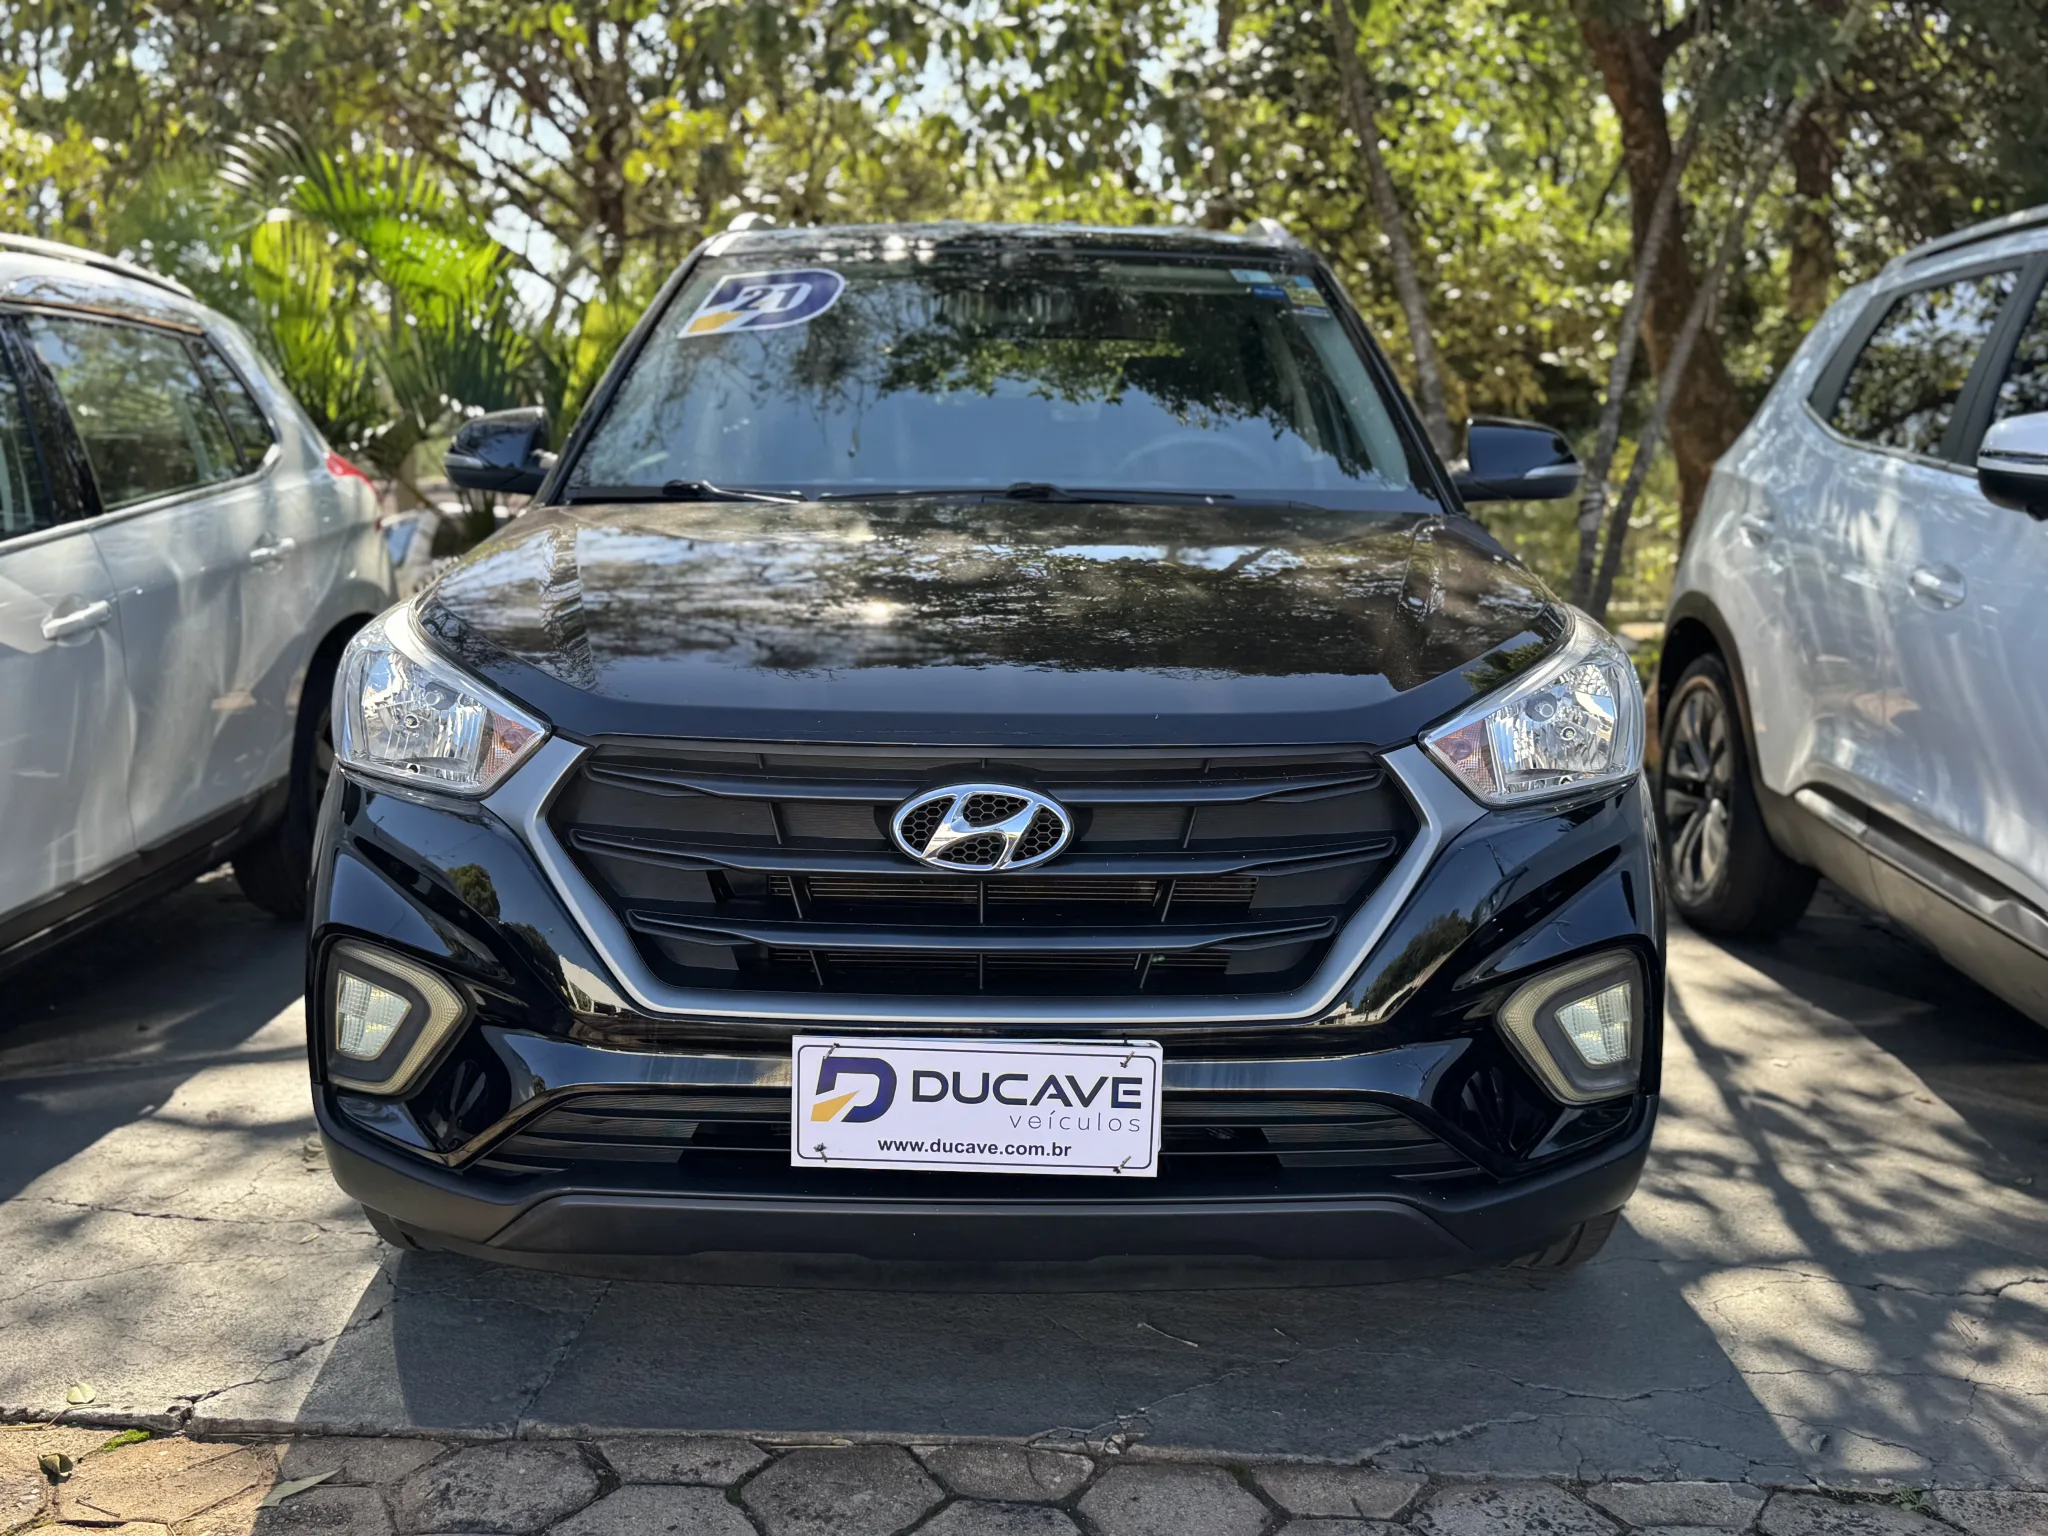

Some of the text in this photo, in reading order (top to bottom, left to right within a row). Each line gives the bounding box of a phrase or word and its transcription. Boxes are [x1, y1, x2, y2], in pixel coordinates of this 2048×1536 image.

[733, 285, 802, 312] 21
[912, 1069, 1143, 1109] DUCAVE
[1009, 1110, 1141, 1132] veículos
[877, 1138, 1073, 1157] www.ducave.com.br
